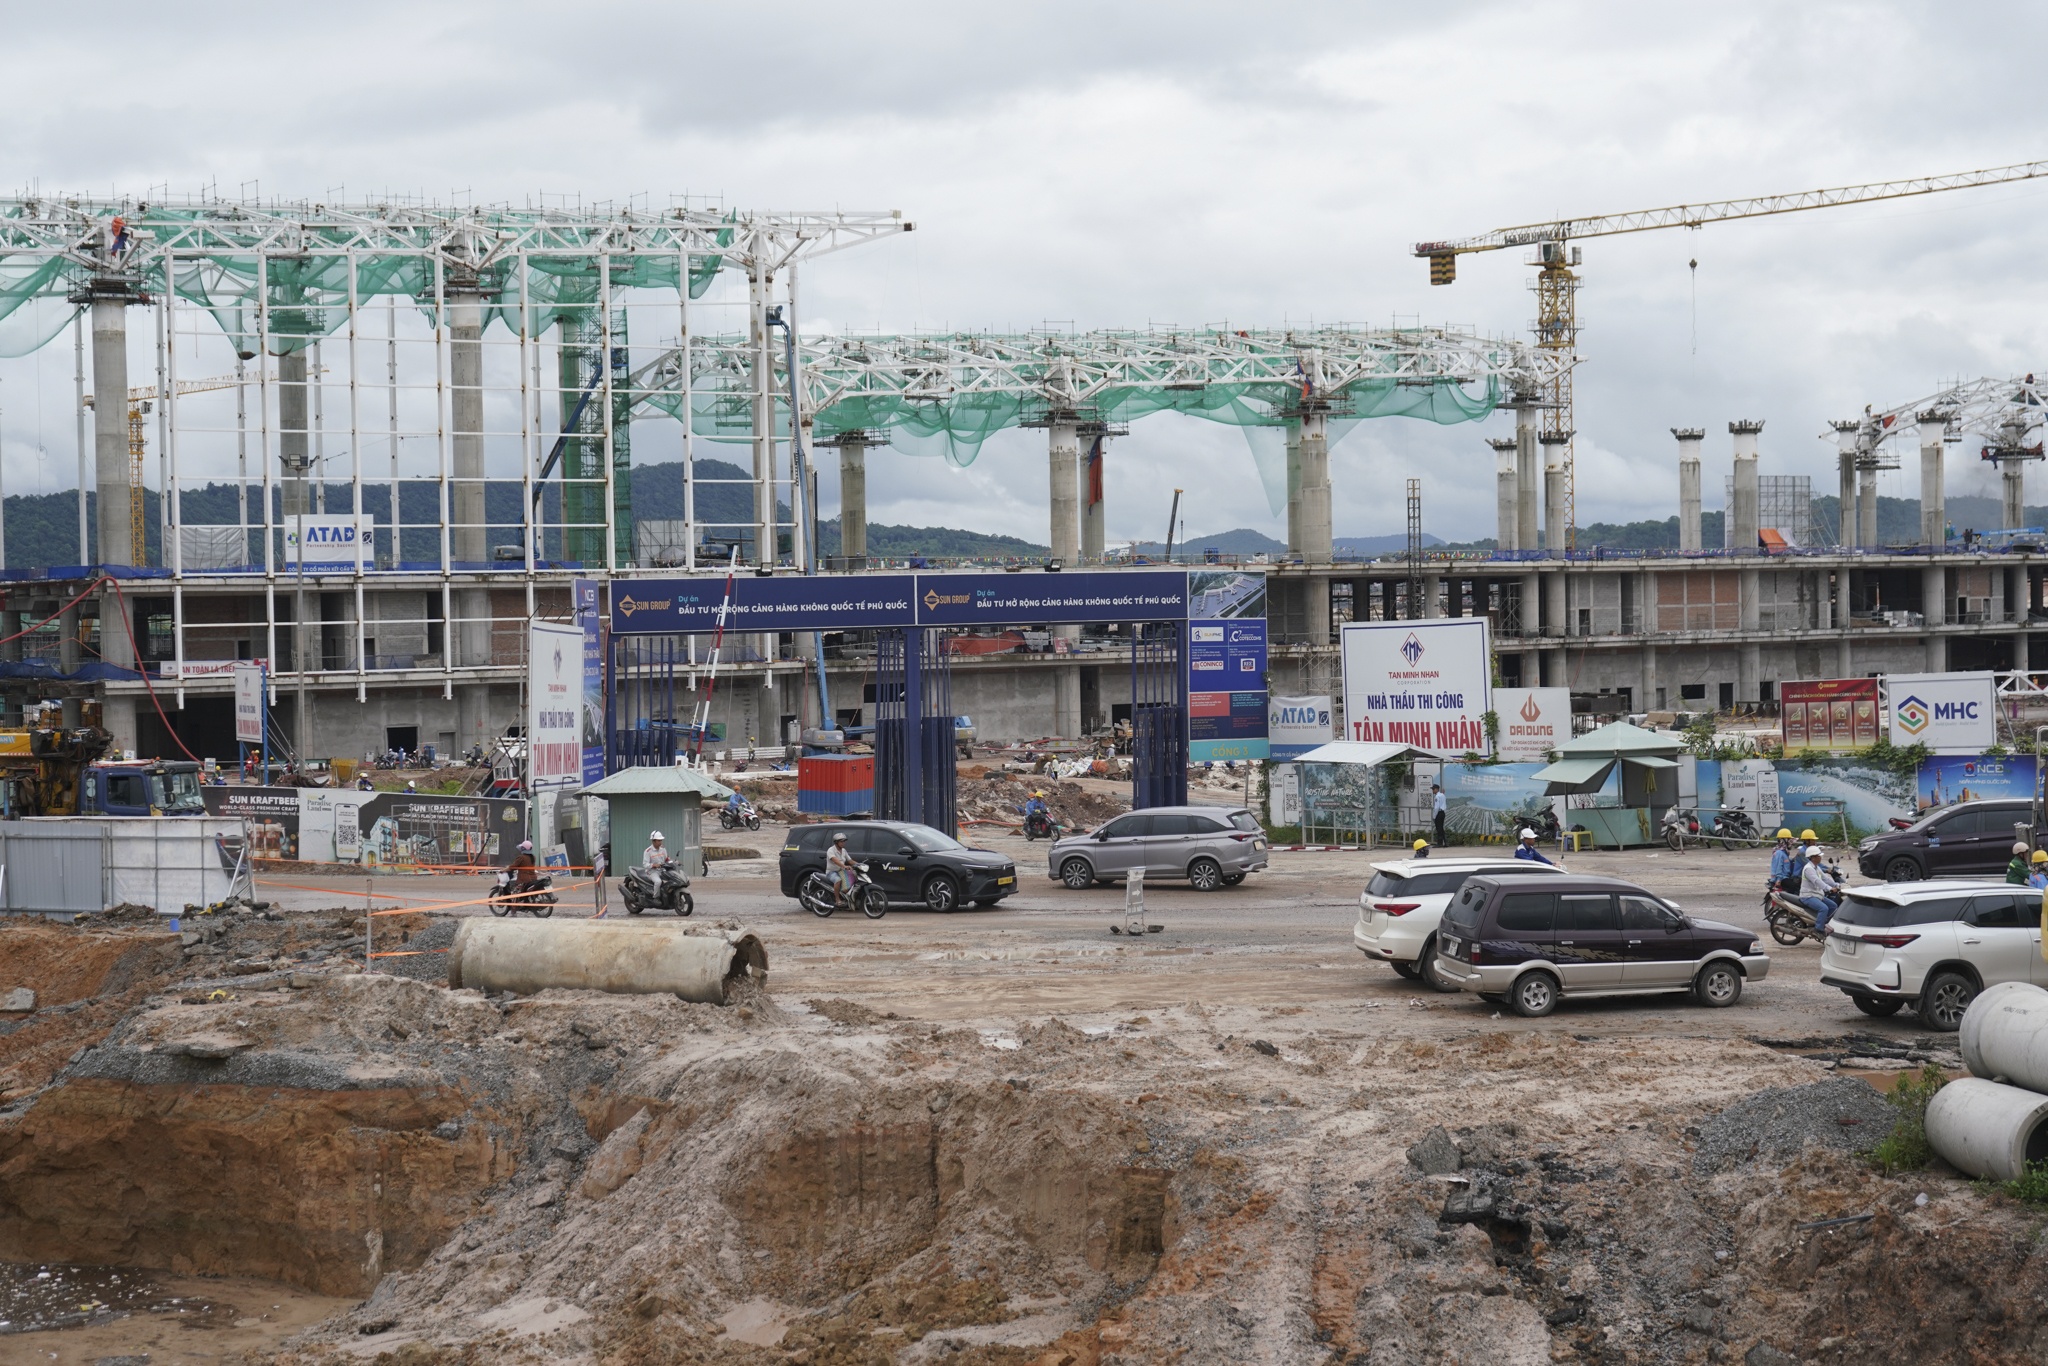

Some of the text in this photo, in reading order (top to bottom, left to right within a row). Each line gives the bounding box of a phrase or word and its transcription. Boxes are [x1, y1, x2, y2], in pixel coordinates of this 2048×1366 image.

[307, 527, 355, 542] ATAD
[678, 596, 688, 604] Dự
[940, 594, 970, 604] SUN GROUP
[976, 598, 992, 608] ĐẦU
[994, 600, 1005, 608] TƯ
[1006, 598, 1018, 607] MỞ
[1020, 598, 1040, 608] RỘNG
[1042, 597, 1062, 606] CẢNG
[1086, 596, 1110, 606] KHÔNG
[1112, 595, 1132, 606] QUỐC
[1134, 595, 1144, 604] TẾ
[1145, 596, 1158, 604] PHÚ
[1160, 594, 1180, 604] QUỐC
[636, 601, 650, 610] SUN
[650, 600, 670, 610] GROUP
[678, 604, 696, 614] ĐẦU
[698, 605, 710, 614] TƯ
[726, 604, 750, 615] RỘNG
[752, 602, 774, 612] CẢNG
[800, 602, 829, 612] KHÔNG
[830, 600, 854, 611] QUỐC
[856, 600, 866, 610] TẾ
[868, 600, 883, 610] PHÚ
[885, 599, 908, 610] QUỐC
[1368, 690, 1464, 710] NHÀ THẦU THI CÔNG
[1281, 707, 1316, 723] ATAD
[1934, 702, 1978, 720] MHC
[1354, 715, 1482, 749] TÂN MINH NHÂN
[1510, 726, 1553, 736] DAIDUNG
[1243, 746, 1249, 756] 3
[1462, 775, 1513, 785] KEM BEACH
[1728, 780, 1744, 788] Land
[1786, 785, 1818, 794] REFINED
[229, 795, 300, 805] SUN KRAFTBEER
[409, 804, 426, 812] SUN
